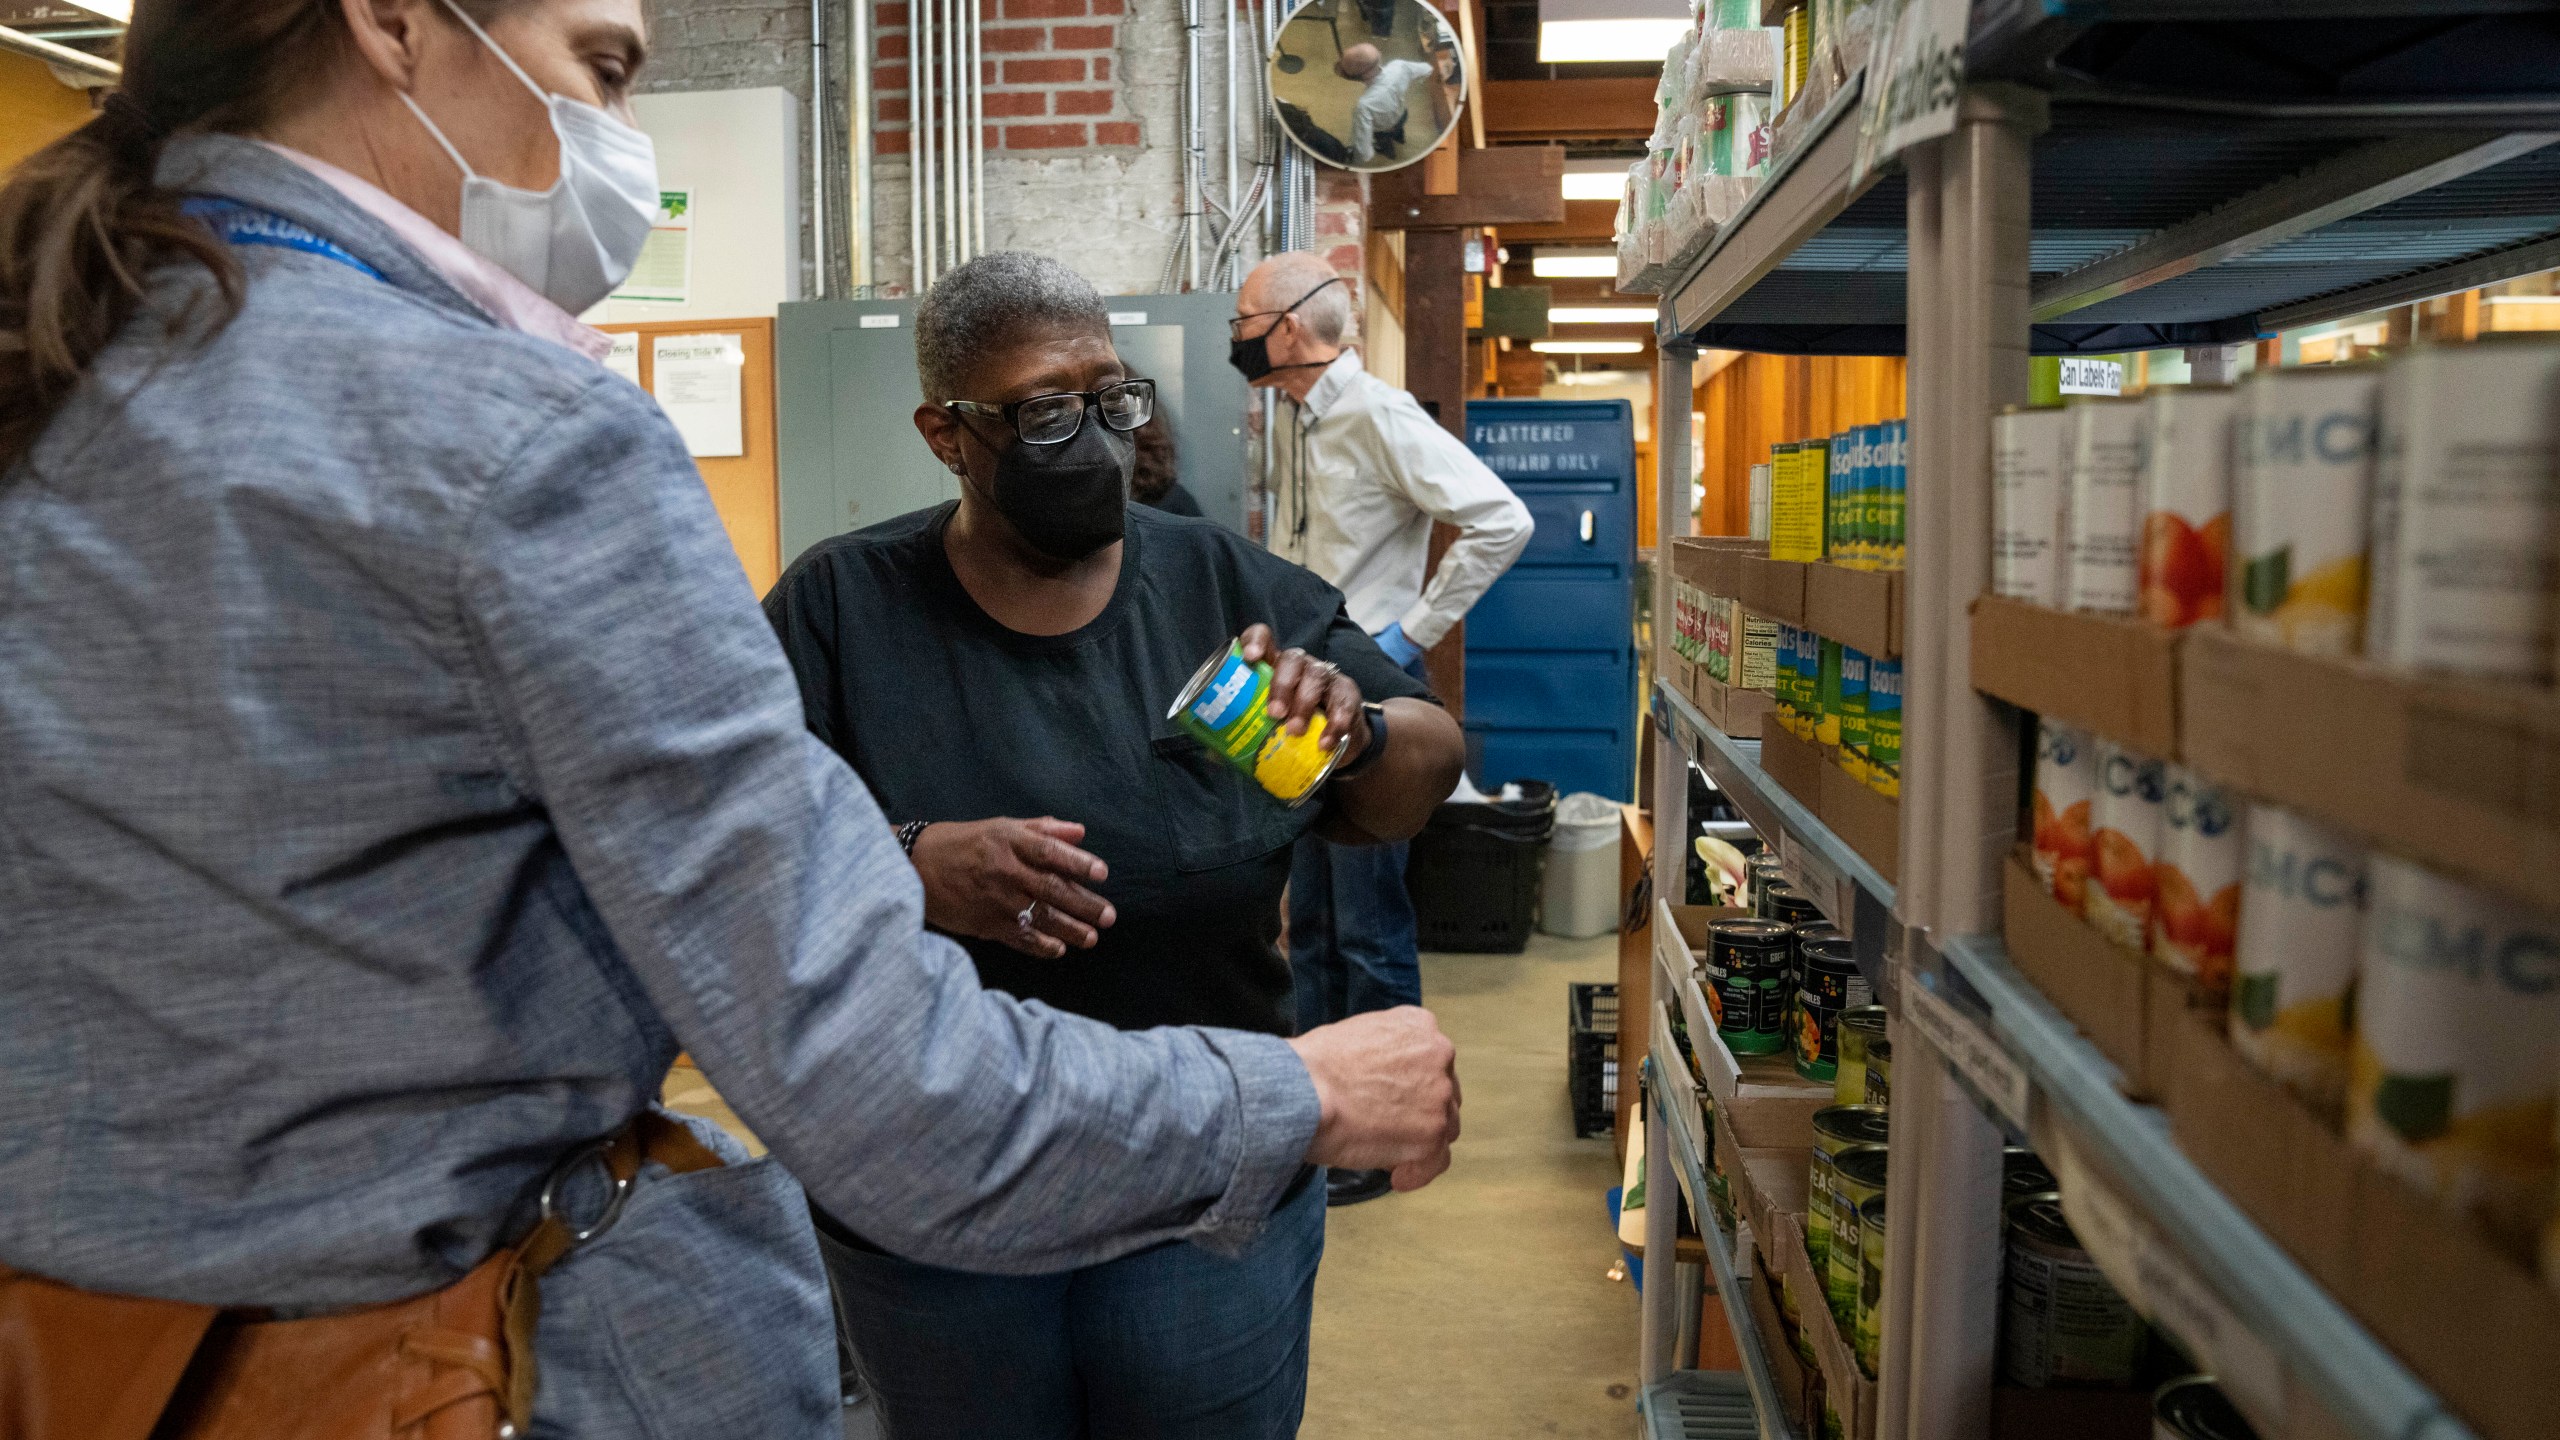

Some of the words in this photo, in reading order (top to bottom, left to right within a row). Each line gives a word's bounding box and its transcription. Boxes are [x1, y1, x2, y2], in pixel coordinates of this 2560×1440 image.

[657, 349, 691, 359] Closing
[2060, 358, 2077, 387] Can
[2079, 360, 2105, 388] Labels
[1475, 426, 1575, 443] FLATTENED
[1556, 454, 1600, 470] ONLY
[1745, 639, 1772, 647] Calories
